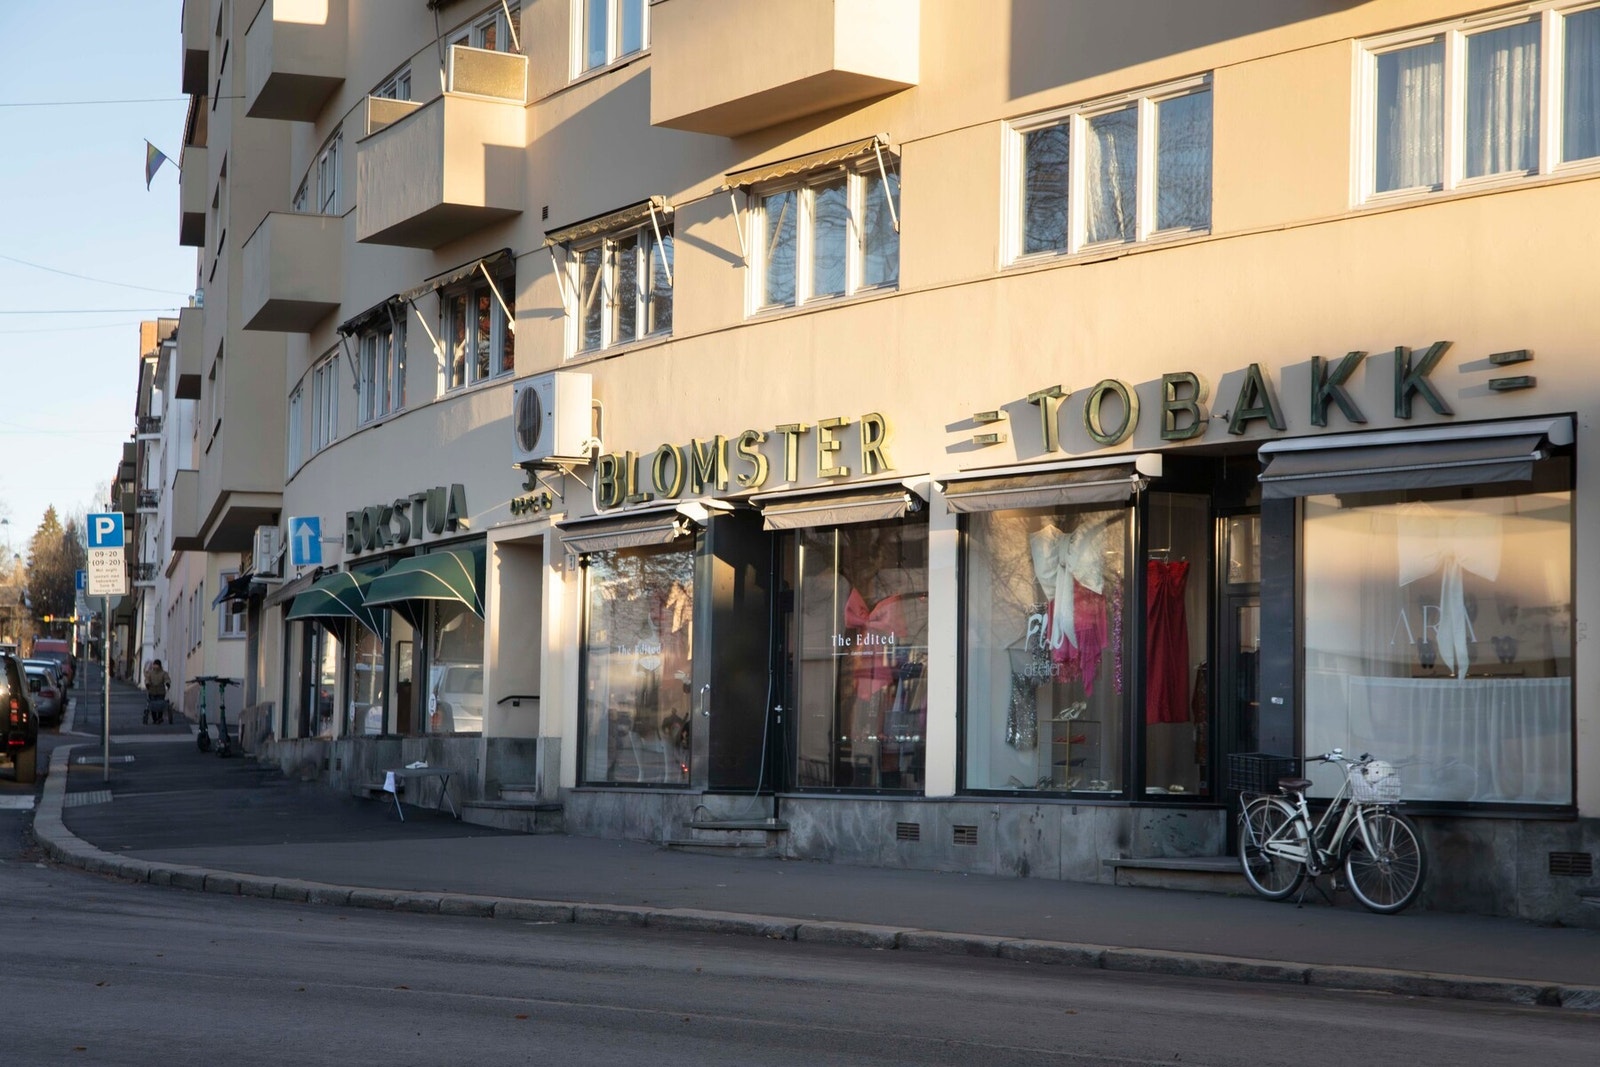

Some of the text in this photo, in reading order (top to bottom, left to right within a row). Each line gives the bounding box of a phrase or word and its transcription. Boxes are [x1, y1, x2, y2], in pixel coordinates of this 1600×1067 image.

[1028, 340, 1455, 453] TOBAKK
[598, 411, 894, 508] BLOMSTER
[95, 517, 115, 545] P
[345, 483, 470, 555] BOKSTUA
[831, 631, 895, 647] The Edited
